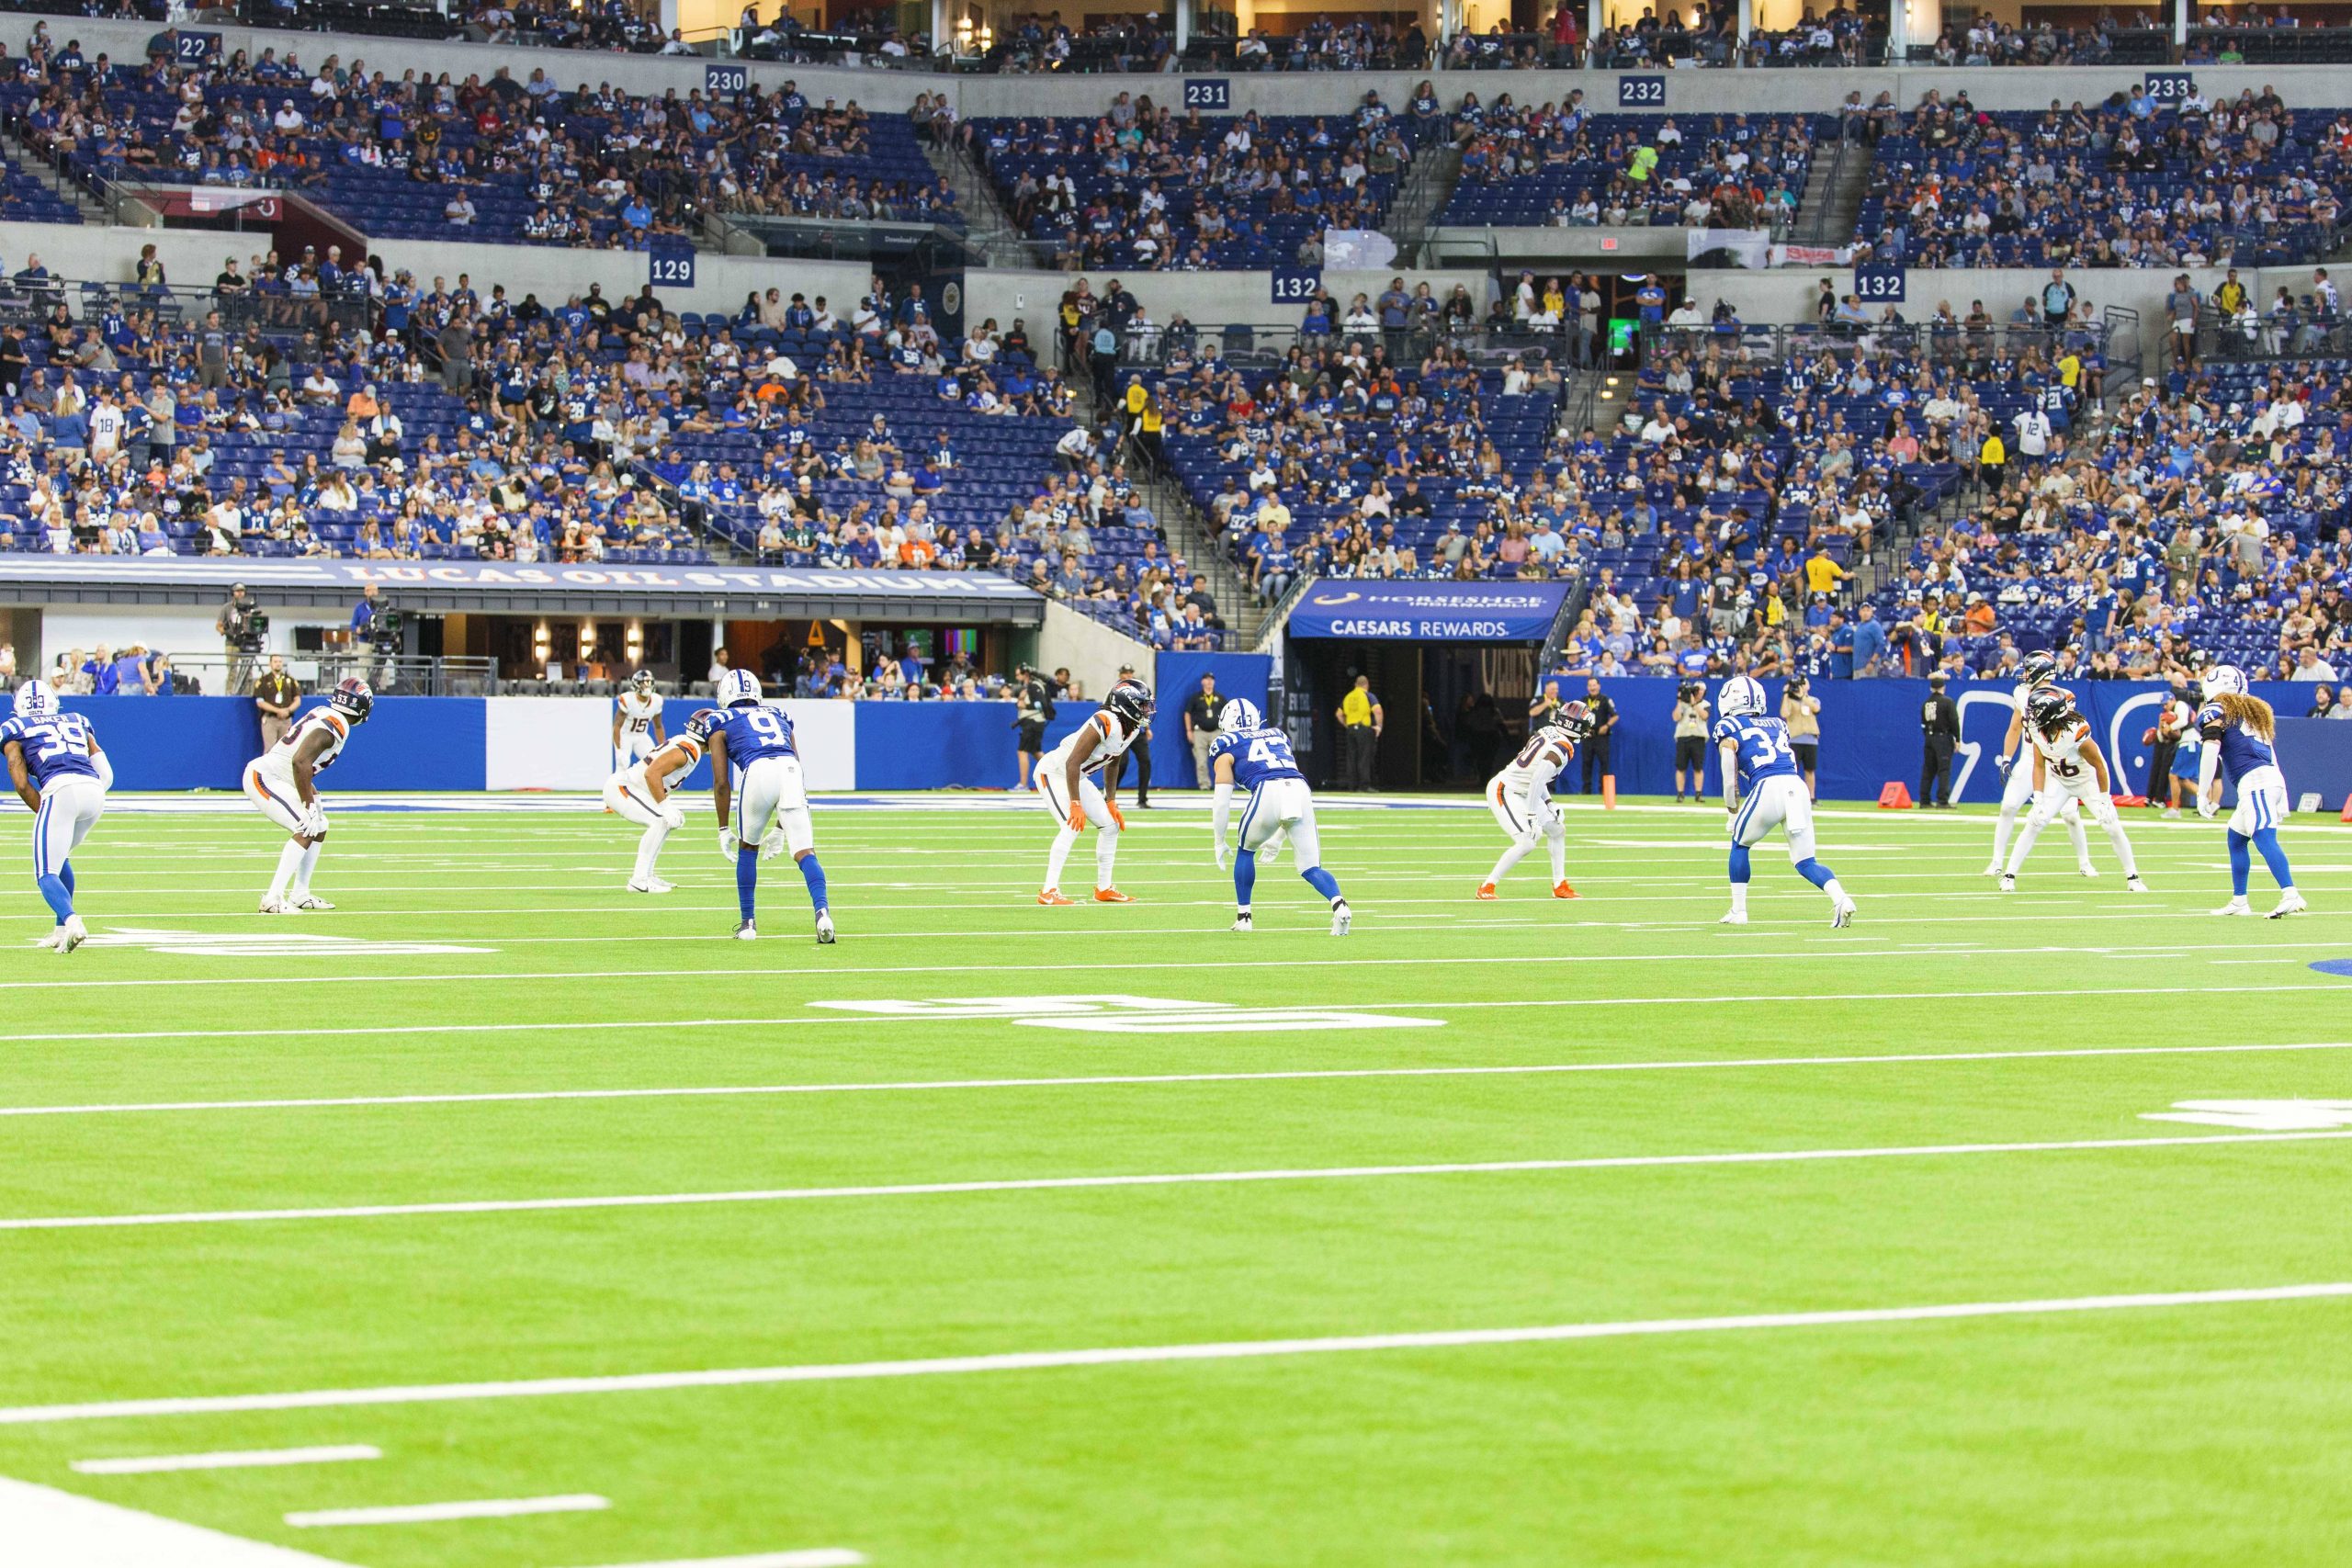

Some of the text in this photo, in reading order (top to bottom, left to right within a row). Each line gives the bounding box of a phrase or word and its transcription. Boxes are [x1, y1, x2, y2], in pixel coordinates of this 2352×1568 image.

[181, 38, 206, 57] 22
[708, 72, 744, 90] 230
[2148, 79, 2188, 97] 233
[1188, 85, 1227, 103] 231
[1623, 82, 1663, 99] 232
[787, 98, 801, 108] 12
[1418, 99, 1430, 110] 56
[653, 260, 690, 280] 129
[1276, 277, 1315, 297] 132
[1860, 276, 1900, 295] 132
[109, 321, 119, 333] 11
[1792, 376, 1804, 389] 11
[569, 402, 585, 419] 28
[99, 418, 112, 433] 18
[2027, 423, 2039, 434] 12
[1338, 486, 1351, 497] 12
[797, 535, 808, 547] 11
[343, 566, 977, 591] LUCAS OIL STADIUM
[1369, 595, 1542, 604] HORSESHOE
[1331, 620, 1411, 636] CAESARS
[744, 680, 752, 693] 9
[26, 695, 44, 709] 39
[337, 694, 347, 705] 53
[1743, 694, 1761, 705] 34
[31, 716, 68, 724] BAKER
[630, 717, 649, 733] 15
[1236, 715, 1252, 728] 43
[1564, 719, 1574, 729] 30
[1749, 717, 1779, 728] SCOTT
[747, 711, 786, 747] 9
[23, 723, 89, 763] 39
[1740, 728, 1798, 773] 34
[1248, 737, 1298, 771] 43
[805, 995, 1447, 1032] 50
